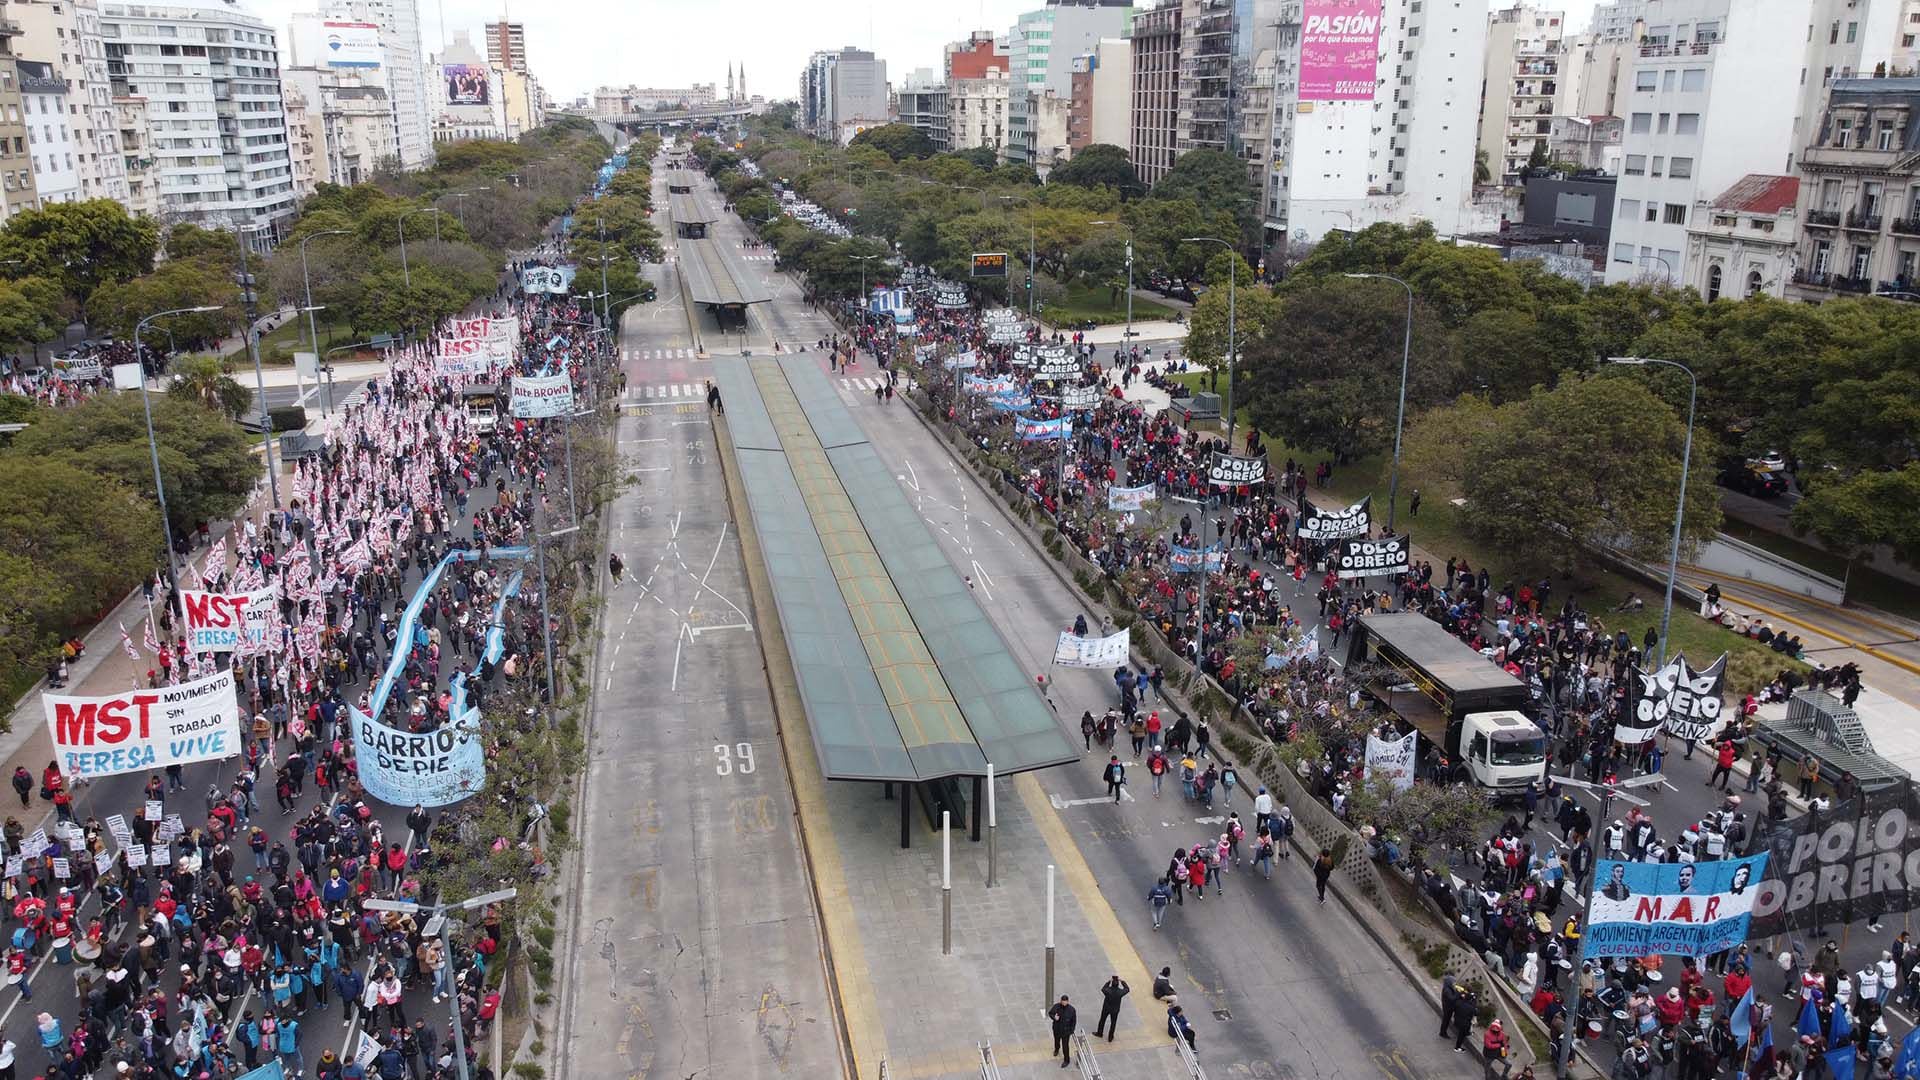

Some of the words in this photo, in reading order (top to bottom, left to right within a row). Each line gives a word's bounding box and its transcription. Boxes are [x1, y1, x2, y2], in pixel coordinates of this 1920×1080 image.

[1305, 10, 1378, 34] PASIÓN
[1304, 36, 1318, 44] por
[1327, 36, 1341, 44] que
[1342, 35, 1374, 43] hacemos
[937, 297, 967, 305] OBRERO
[986, 309, 1012, 318] POLO
[995, 325, 1022, 334] POLO
[1041, 363, 1080, 373] OBRERO
[1045, 356, 1075, 365] POLO
[534, 383, 569, 398] BROWN
[1221, 459, 1261, 472] POLO
[1212, 467, 1264, 481] OBRERO
[1307, 513, 1367, 532] OBRERO
[1349, 541, 1400, 556] POLO
[1341, 550, 1407, 568] OBRERO
[185, 593, 249, 629] MST
[192, 630, 237, 645] ERESA
[164, 677, 229, 703] MOVIMIENTO
[55, 695, 159, 746] MST
[166, 707, 185, 719] SIN
[170, 713, 222, 736] TRABAJO
[362, 719, 470, 758] BARRIOS
[65, 744, 155, 774] TERESA
[170, 730, 227, 759] VIVE
[714, 742, 756, 776] 39
[378, 753, 409, 773] DE
[413, 756, 449, 775] PIE
[1788, 808, 1907, 874] POLO
[1592, 923, 1652, 943] MOVIMIENT
[1652, 926, 1711, 943] ARGENTINA
[1600, 941, 1672, 956] GUEVARMO
[1674, 943, 1692, 954] EN
